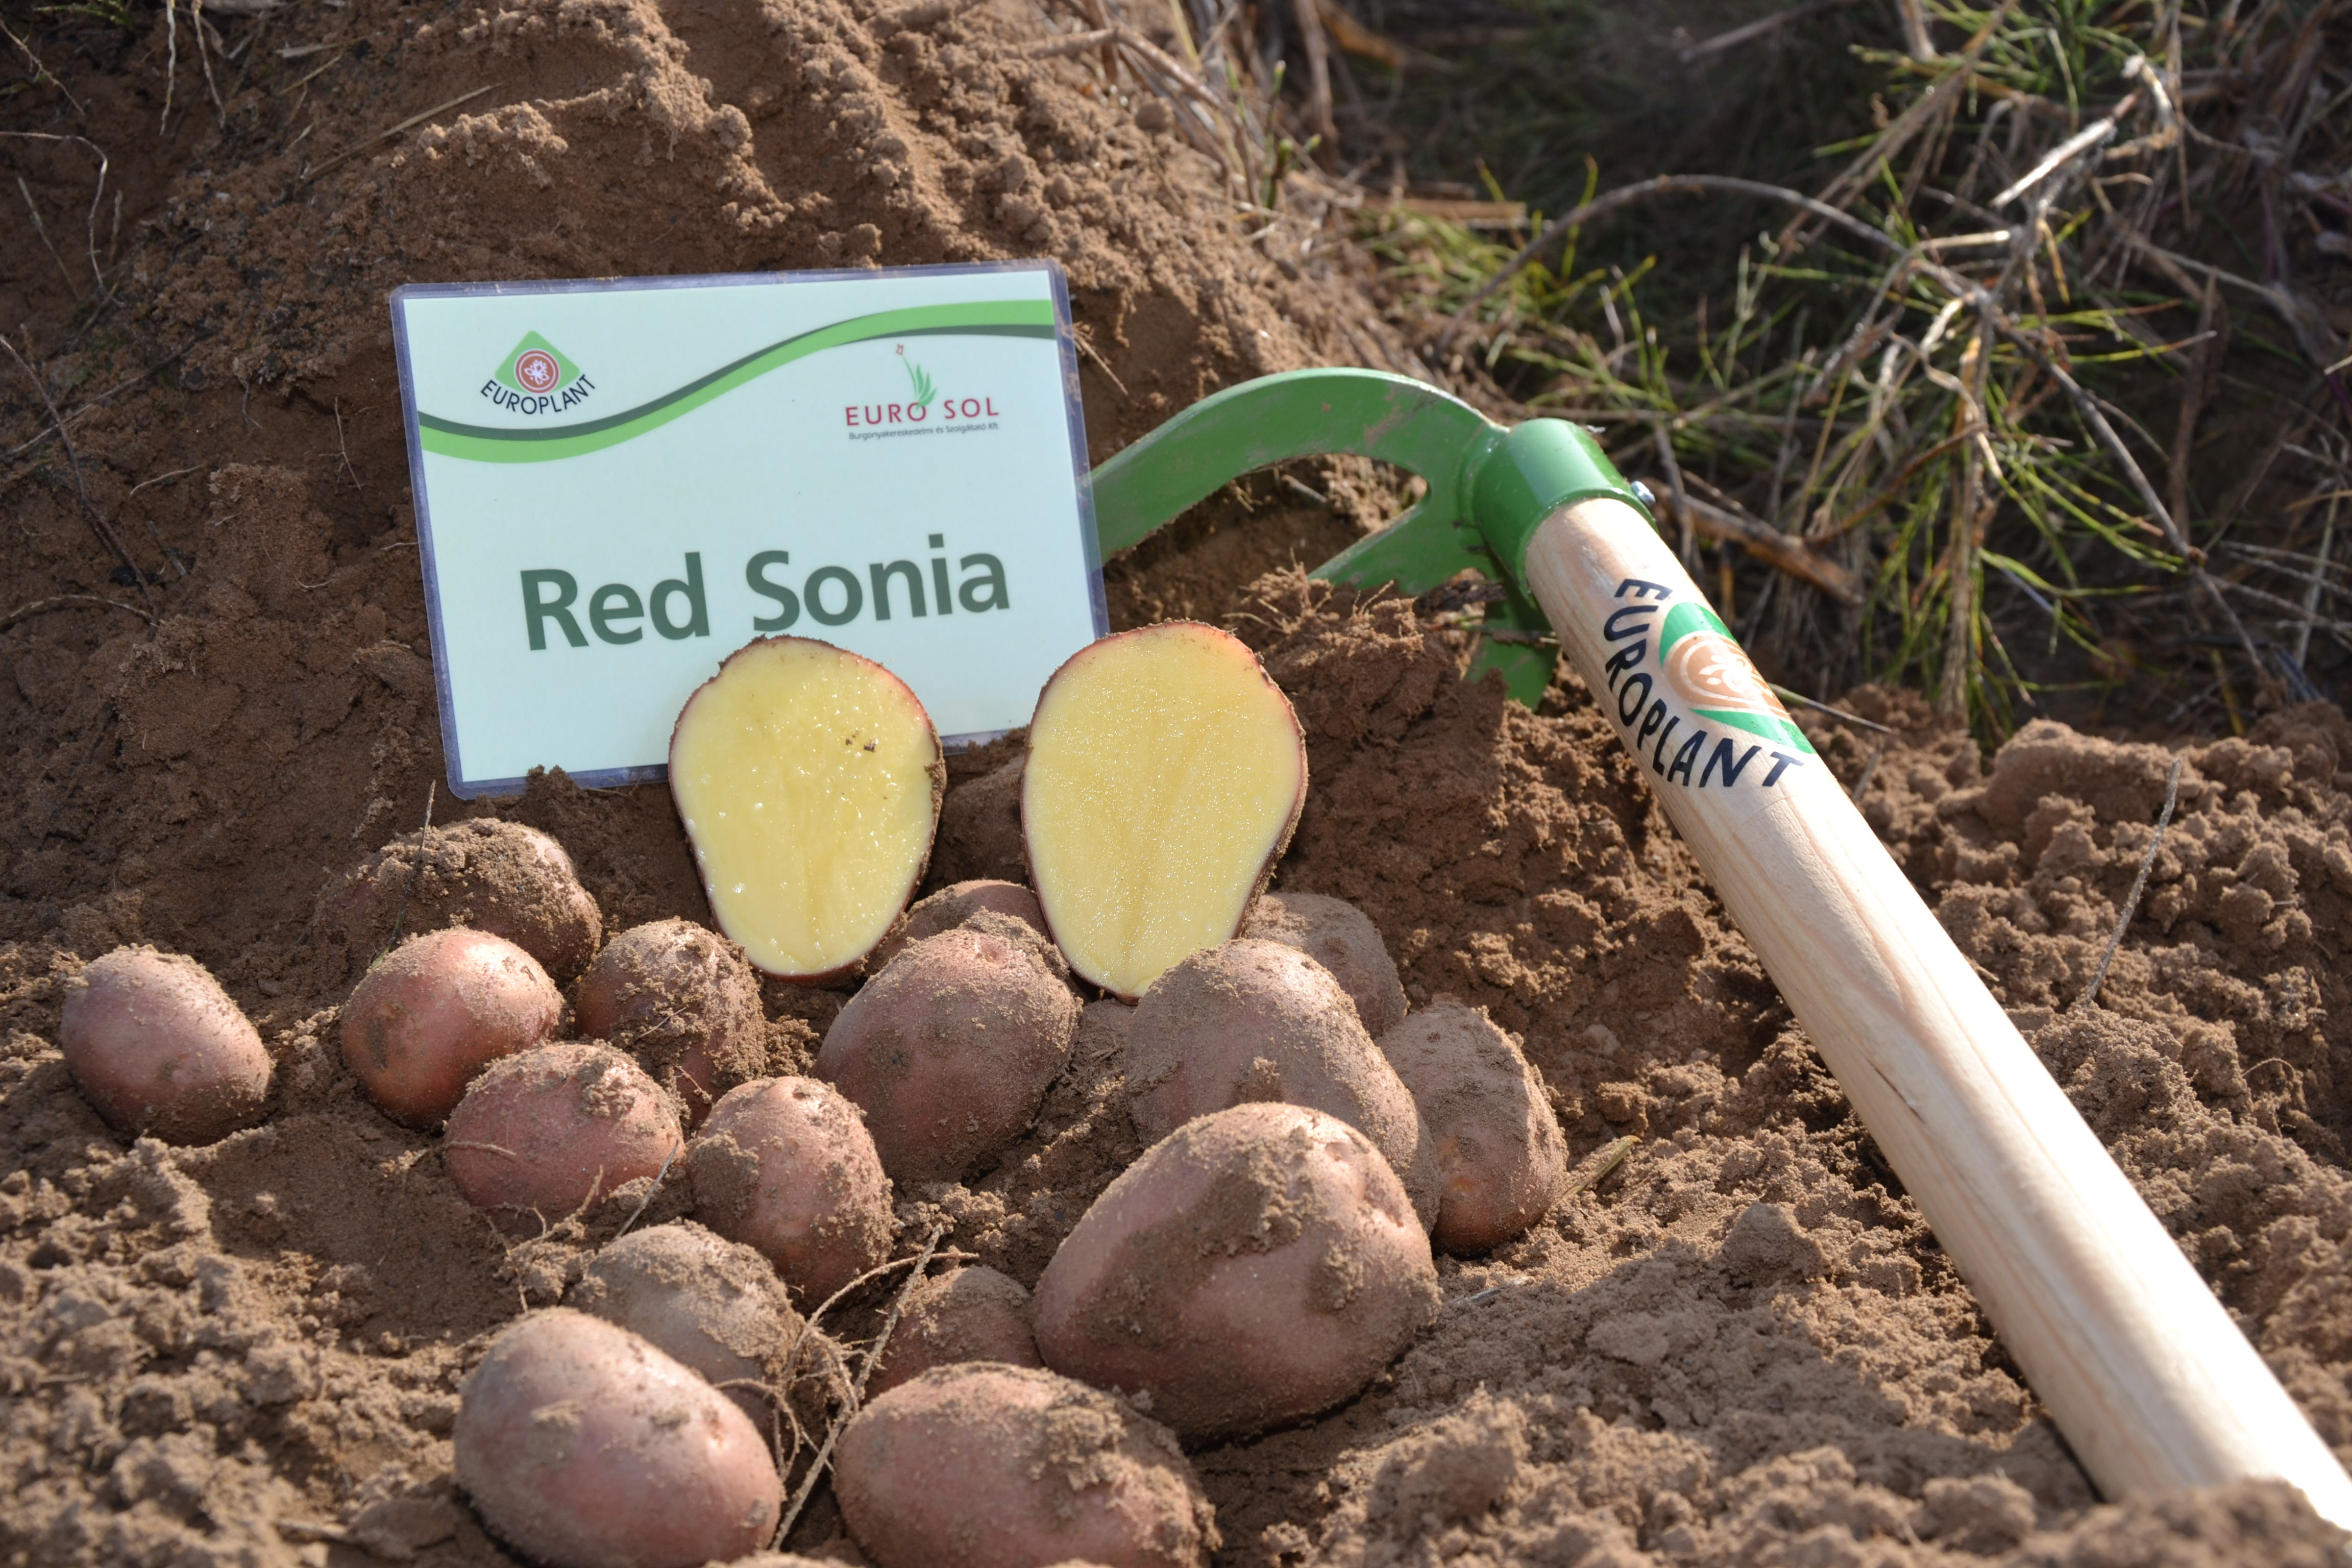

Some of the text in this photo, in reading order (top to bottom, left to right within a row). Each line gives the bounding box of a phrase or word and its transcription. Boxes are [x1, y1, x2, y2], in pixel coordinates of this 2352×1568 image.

[480, 374, 596, 414] EUROPLANT
[845, 397, 999, 426] EURO SOL
[849, 427, 934, 440] Burgonyakereskedelmi
[936, 425, 944, 433] és
[946, 423, 986, 433] Szolgáltató
[520, 533, 1011, 651] Red Sonia
[1604, 578, 1805, 788] EUROPLANT
